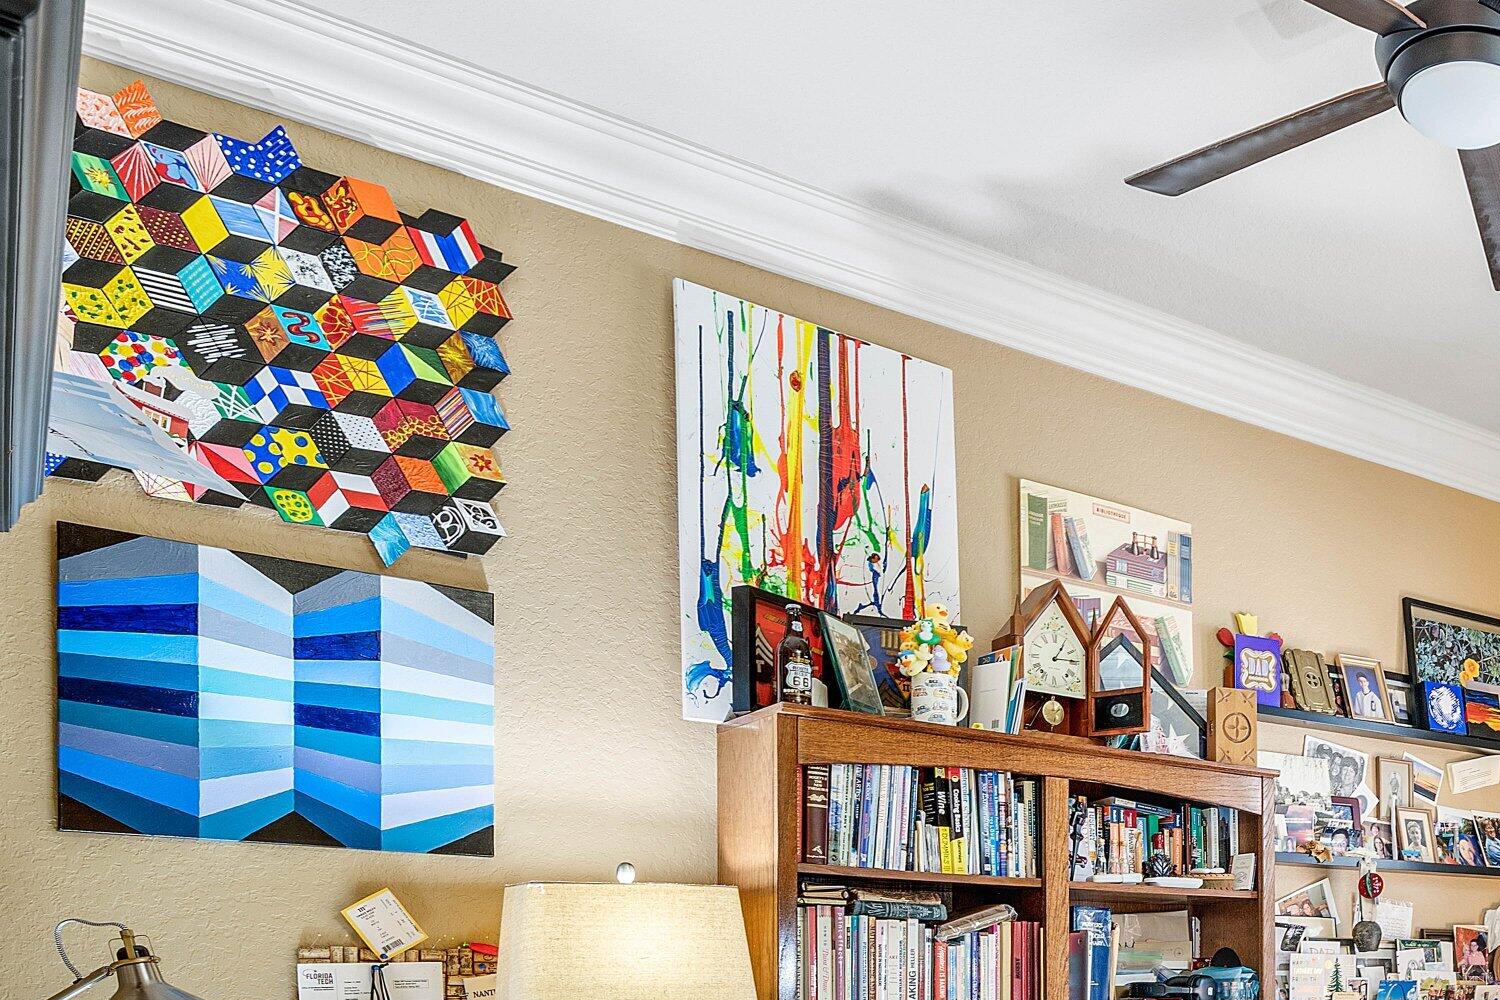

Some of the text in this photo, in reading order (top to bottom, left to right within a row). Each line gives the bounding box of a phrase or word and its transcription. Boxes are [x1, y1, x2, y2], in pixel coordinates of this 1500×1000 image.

[792, 676, 809, 688] 66
[937, 791, 946, 815] Wine
[952, 788, 962, 833] Cooking Basics
[306, 972, 333, 980] FLORIDA
